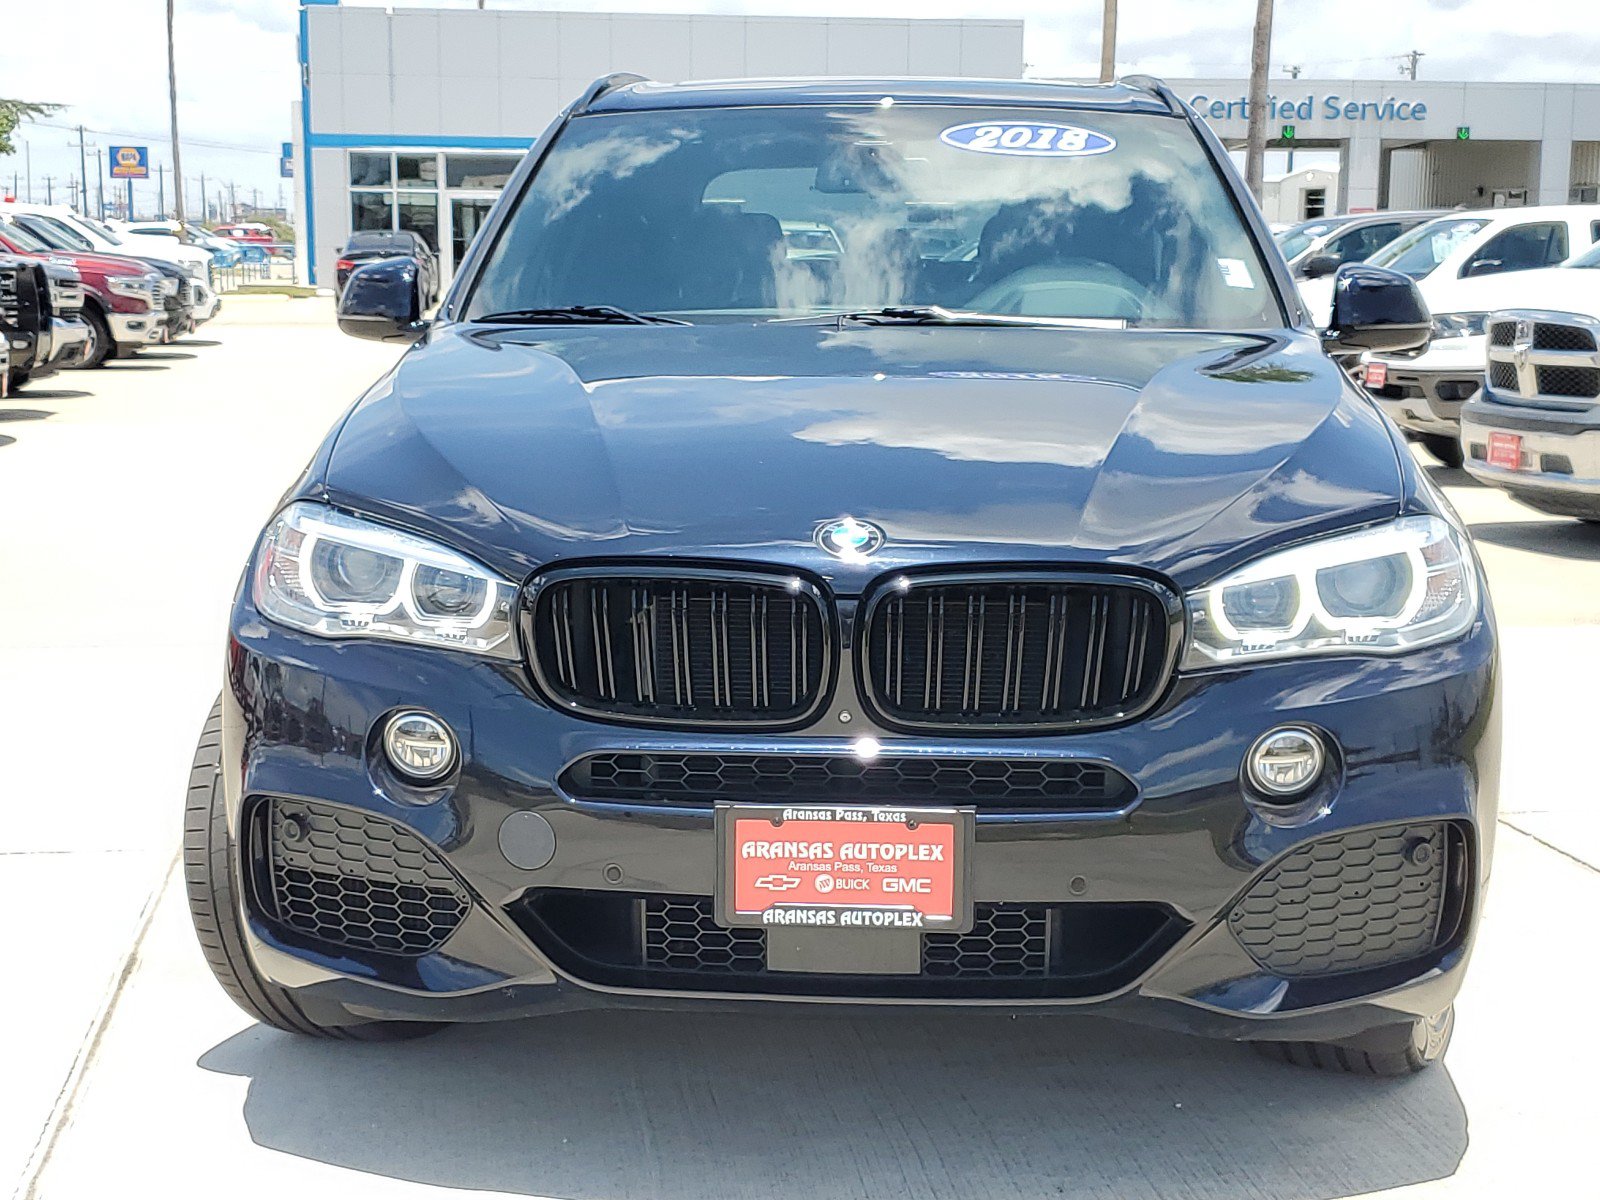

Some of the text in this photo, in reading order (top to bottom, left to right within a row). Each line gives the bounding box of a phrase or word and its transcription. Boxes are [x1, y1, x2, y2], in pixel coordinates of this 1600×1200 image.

[1190, 95, 1427, 121] Certied Service
[968, 126, 1090, 151] 2018
[783, 808, 907, 822] Aransas Pass, Texas
[741, 841, 944, 861] ARANSAS AUTOPLEX
[788, 860, 897, 873] Aransas Pass, Texas
[835, 878, 932, 893] BUICK GMC
[762, 909, 923, 927] ARANSAS AUTOPLEX
